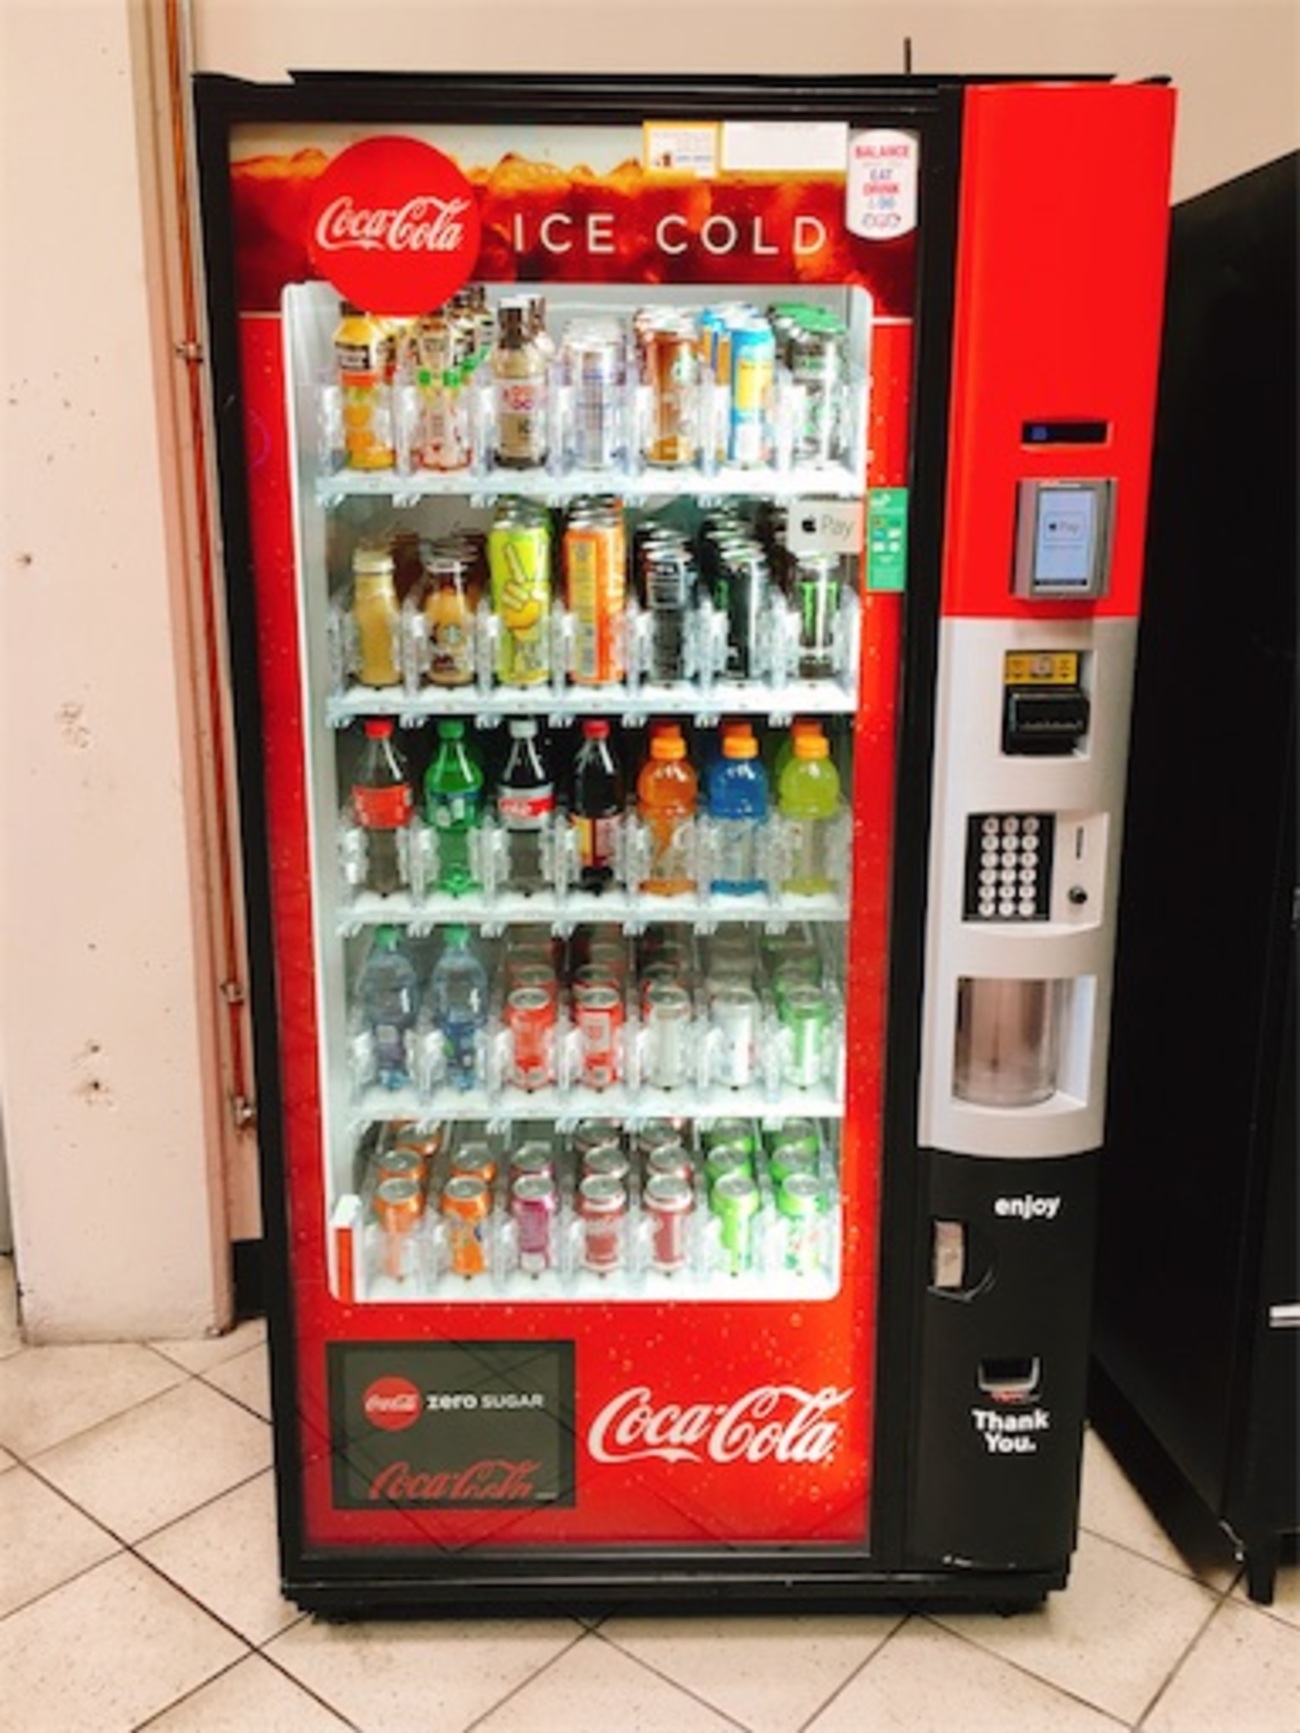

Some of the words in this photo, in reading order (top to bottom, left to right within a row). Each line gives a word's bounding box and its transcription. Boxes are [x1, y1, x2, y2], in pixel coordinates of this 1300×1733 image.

[855, 145, 910, 159] BALANCE
[315, 195, 471, 252] Coca-Cola
[514, 213, 615, 253] ICE
[656, 214, 827, 255] COLD
[822, 515, 855, 540] Pay
[994, 1194, 1061, 1220] enjoy
[426, 1394, 478, 1411] zero
[480, 1393, 544, 1410] SUGAR
[587, 1386, 854, 1464] Coca-Cola
[971, 1408, 1050, 1433] Thank
[984, 1433, 1037, 1453] You.
